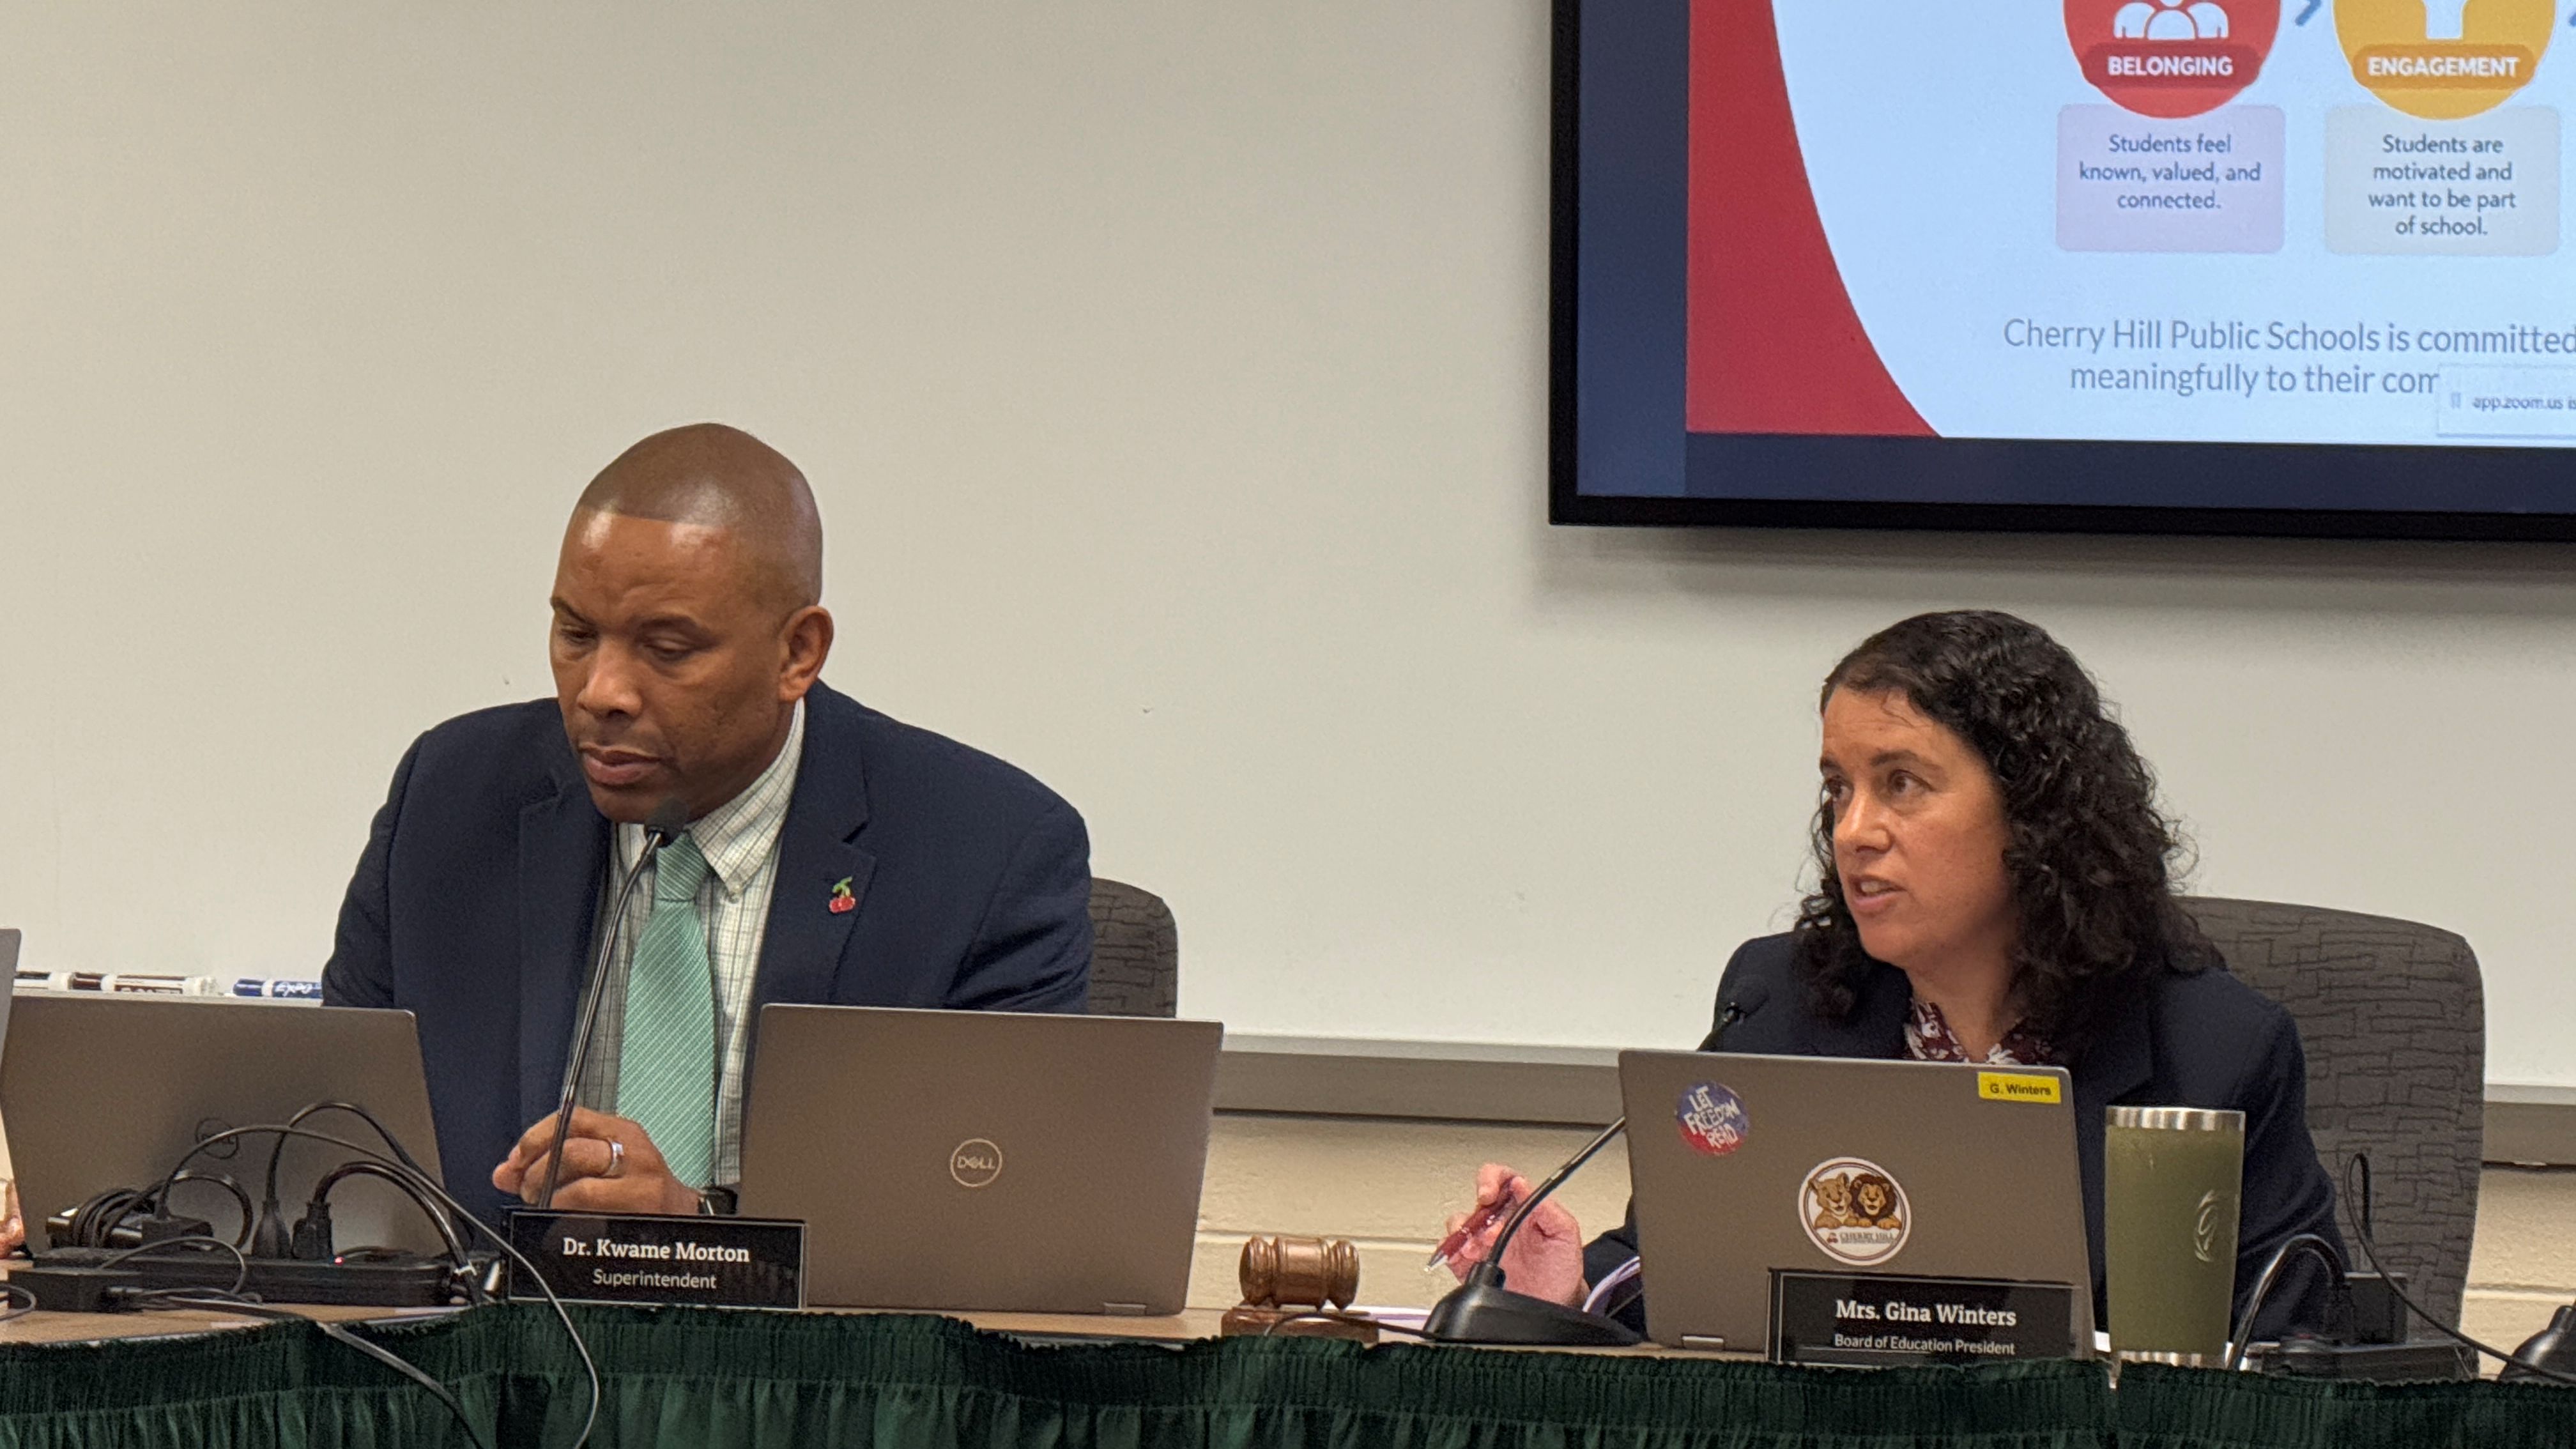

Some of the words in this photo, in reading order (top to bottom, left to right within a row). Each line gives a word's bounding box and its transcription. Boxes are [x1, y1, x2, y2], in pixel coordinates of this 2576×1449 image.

[2108, 56, 2234, 76] BELONGING
[2368, 56, 2519, 77] ENGAGEMENT
[2109, 132, 2191, 153] Students
[2197, 133, 2231, 153] feel
[2382, 133, 2467, 154] Students
[2472, 139, 2504, 154] are
[2079, 161, 2147, 183] known,
[2152, 161, 2220, 183] valued,
[2225, 162, 2262, 181] and
[2373, 162, 2471, 181] motivated
[2476, 162, 2512, 181] and
[2117, 190, 2222, 209] connected.
[2368, 191, 2416, 208] want
[2421, 191, 2441, 208] to
[2447, 188, 2471, 208] be
[2477, 192, 2517, 212] part
[2395, 215, 2415, 236] of
[2420, 215, 2488, 236] school.
[2004, 318, 2105, 355] Cherry
[2113, 319, 2161, 349] Hill
[2172, 319, 2260, 350] Public
[2267, 321, 2380, 351] Schools
[2388, 323, 2410, 352] is
[2418, 324, 2576, 353] committed
[2071, 362, 2259, 398] meaningfully
[2266, 365, 2296, 392] to
[2304, 364, 2375, 393] their
[1689, 1085, 1714, 1112] LET
[1989, 1083, 2004, 1094] G.
[2006, 1084, 2051, 1096] Winters
[957, 1156, 996, 1169] DELL
[562, 1237, 592, 1257] Dr.
[596, 1238, 671, 1259] Kwame
[675, 1241, 751, 1262] Morton
[592, 1268, 717, 1289] Superintendent
[1836, 1299, 1881, 1321] Mrs.
[1885, 1301, 1932, 1322] Gina
[1935, 1303, 2017, 1326] Winters
[1834, 1333, 1873, 1349] Board
[1874, 1335, 1889, 1349] of
[1890, 1335, 1953, 1353] Education
[1955, 1339, 2016, 1356] President
